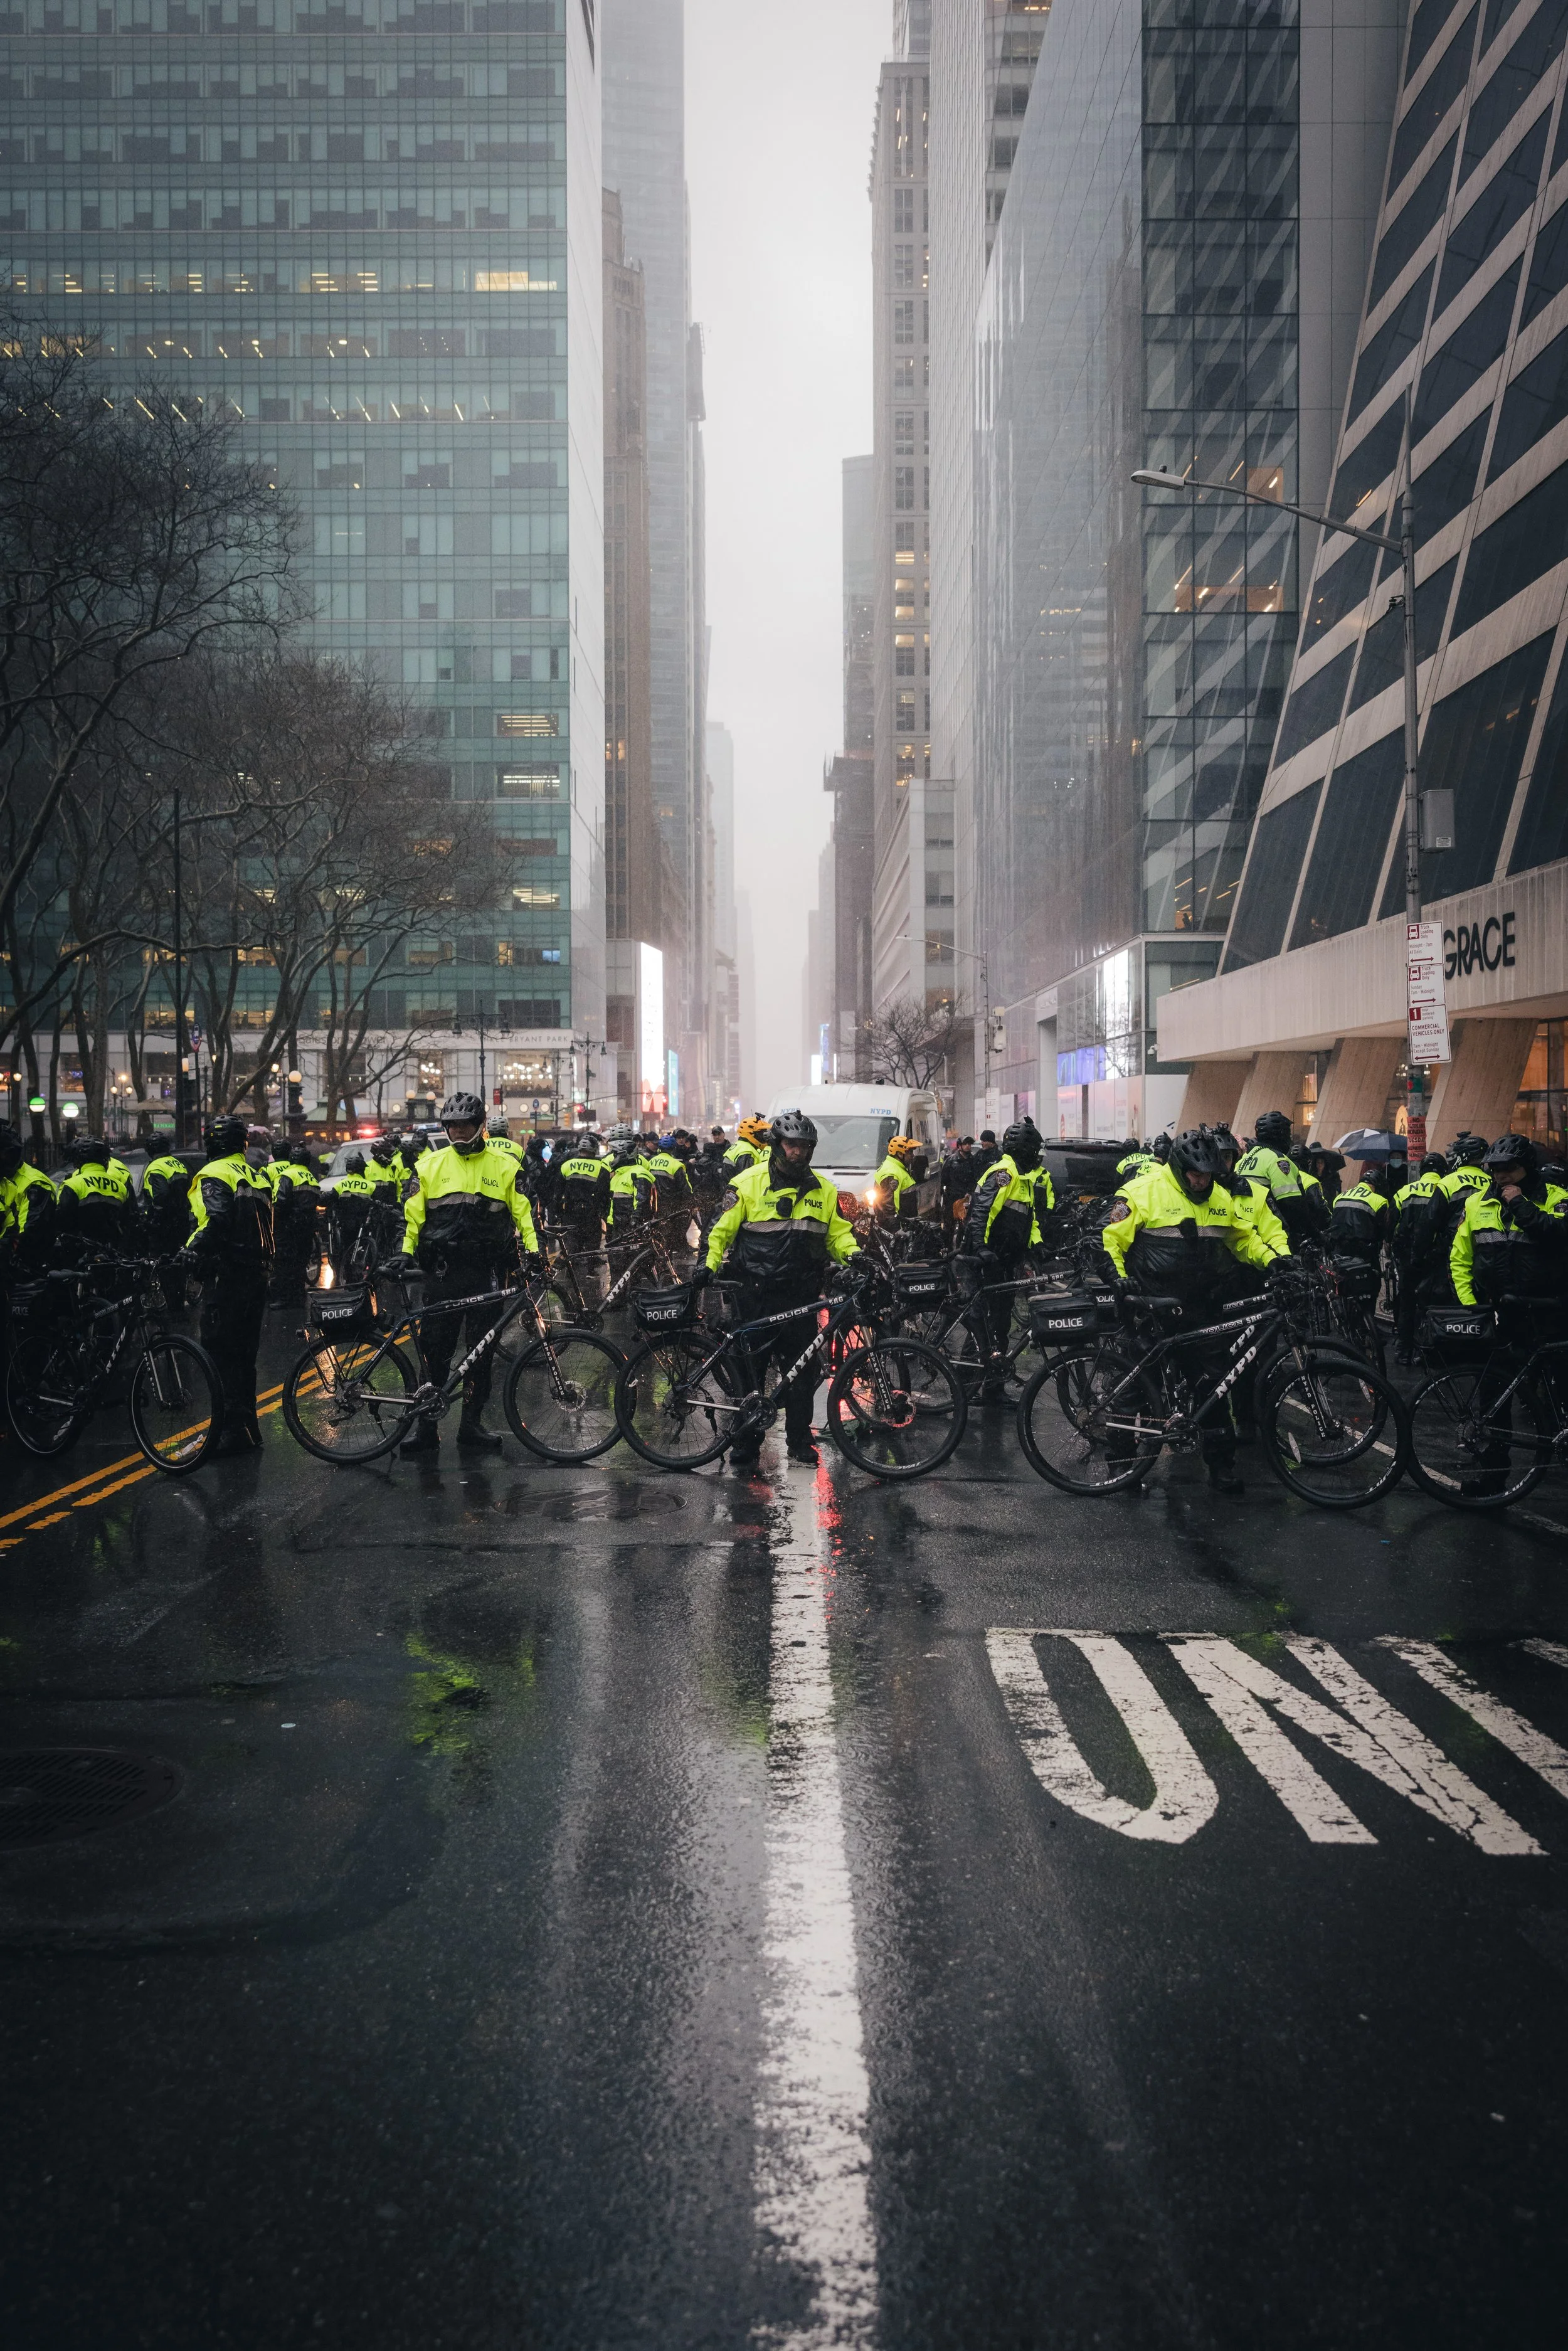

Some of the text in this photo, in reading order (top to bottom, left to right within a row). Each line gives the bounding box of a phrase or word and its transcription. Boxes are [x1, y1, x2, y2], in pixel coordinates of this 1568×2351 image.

[1443, 911, 1515, 980] GRACE
[1412, 1009, 1417, 1020] 1
[1125, 1154, 1146, 1162] NYPD
[569, 1162, 595, 1172] NYPD
[83, 1177, 119, 1193] NYPD
[341, 1180, 368, 1190] NYPD
[1341, 1186, 1372, 1197] NYPD
[804, 1198, 823, 1209] POLICE
[501, 1287, 516, 1296] SRG
[606, 1270, 631, 1303] NYPD
[909, 1283, 935, 1292] POLICE
[123, 1295, 132, 1305] SRG
[12, 1306, 29, 1316] POLICE
[322, 1308, 353, 1320] POLICE
[647, 1310, 677, 1321] POLICE
[770, 1307, 808, 1323] POLICE
[1049, 1317, 1084, 1329] POLICE
[1199, 1313, 1263, 1334] POLICE SRG
[1446, 1324, 1481, 1335] POLICE
[458, 1329, 495, 1377] NYPD
[786, 1333, 824, 1382] NYPD
[543, 1342, 564, 1396] NYPD POLICE
[1215, 1346, 1256, 1399] NYPD
[869, 1352, 891, 1409] NYPD POLICE
[1301, 1376, 1325, 1438] NYPD POLICE
